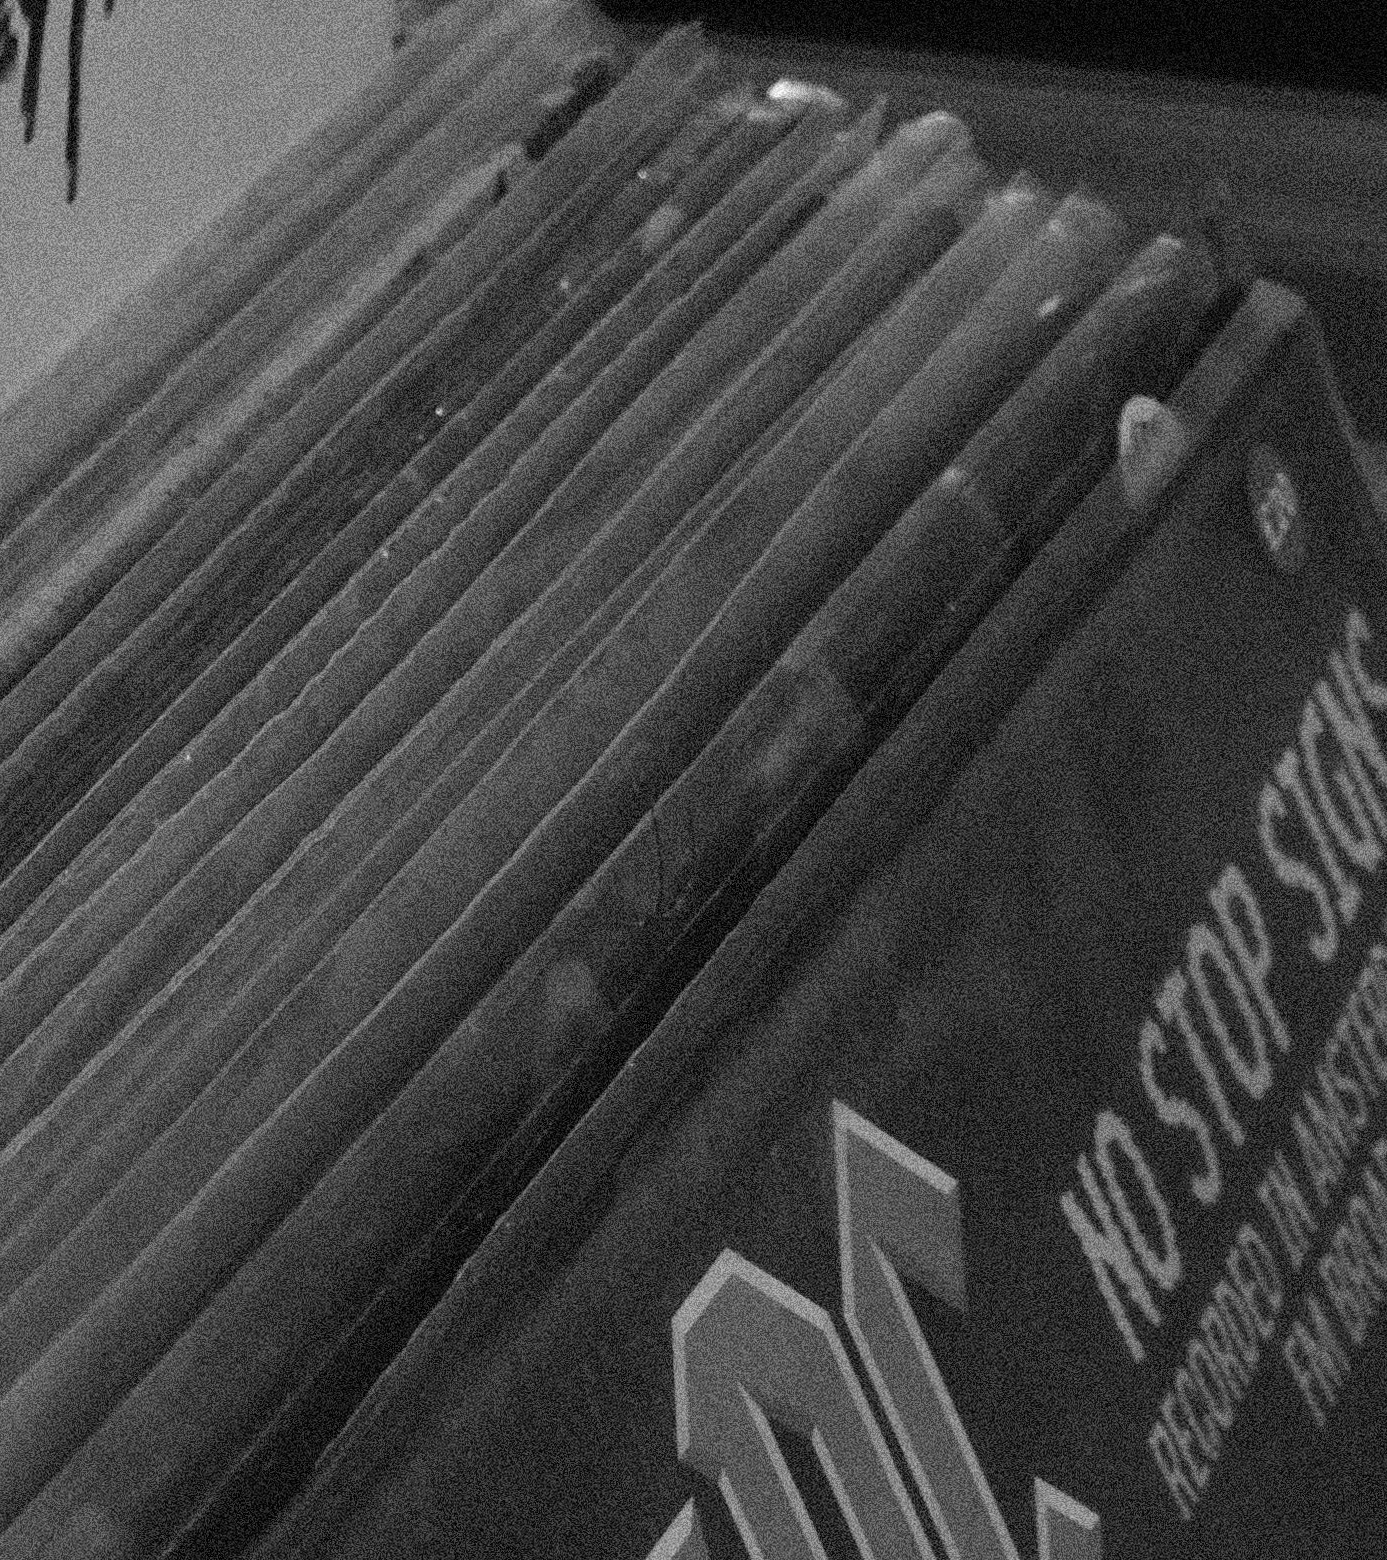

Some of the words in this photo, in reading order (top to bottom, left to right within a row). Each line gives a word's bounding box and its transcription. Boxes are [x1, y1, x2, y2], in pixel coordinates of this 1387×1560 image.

[1061, 1108, 1183, 1365] NO
[1138, 863, 1294, 1209] STOP
[1146, 1224, 1286, 1523] RECORDED
[1256, 1150, 1318, 1267] IN
[1283, 1292, 1355, 1428] FM
